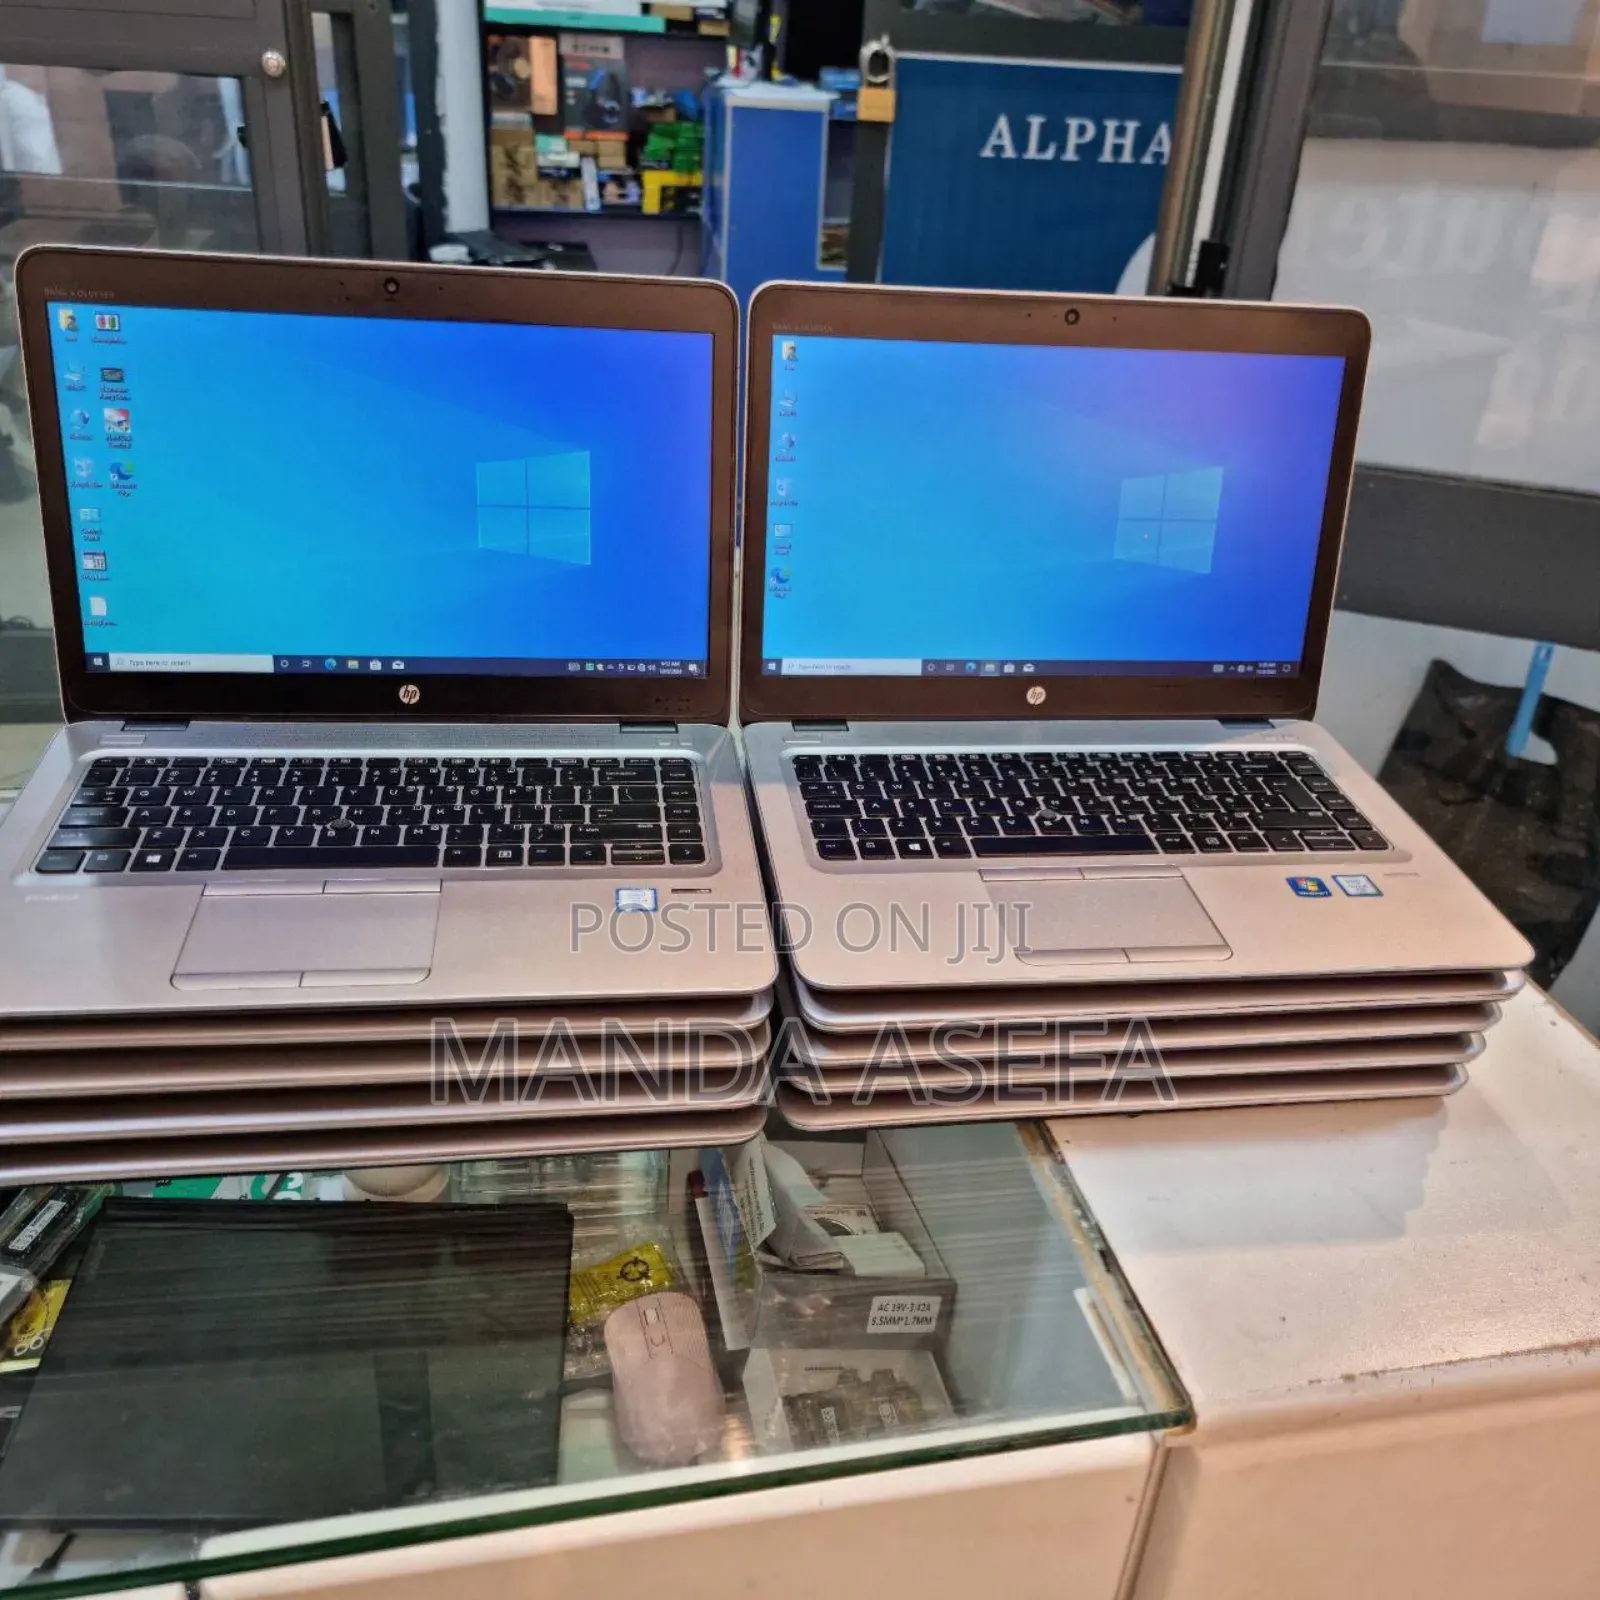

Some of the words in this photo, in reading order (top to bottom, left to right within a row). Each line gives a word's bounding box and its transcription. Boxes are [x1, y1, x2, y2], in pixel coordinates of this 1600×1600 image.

[979, 113, 1172, 165] ALPHA
[399, 684, 421, 705] hp
[877, 1302, 890, 1312] AC
